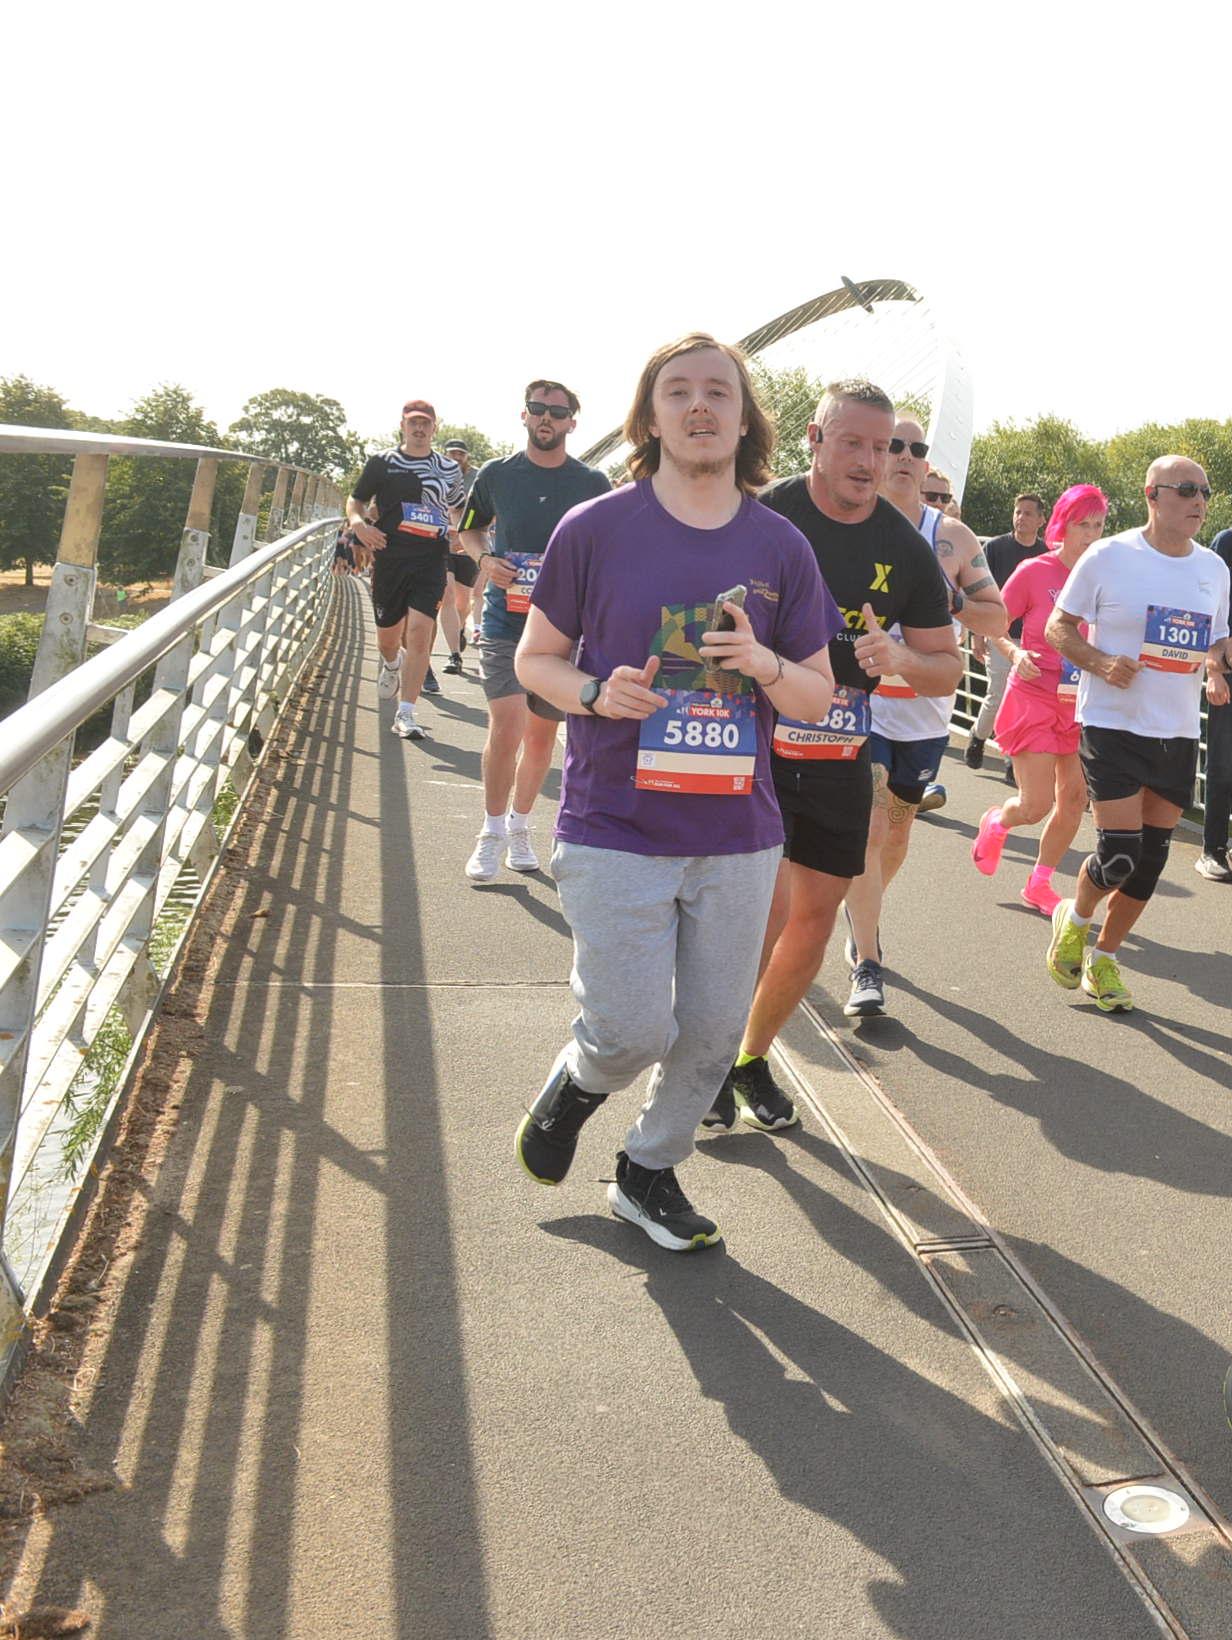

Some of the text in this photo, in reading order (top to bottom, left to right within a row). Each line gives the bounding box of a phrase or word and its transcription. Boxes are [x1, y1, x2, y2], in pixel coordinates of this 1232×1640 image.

[836, 633, 859, 642] CLU
[1159, 625, 1198, 646] 1301
[1162, 649, 1189, 660] DAVID
[691, 707, 716, 717] YORK
[663, 720, 739, 749] 5880
